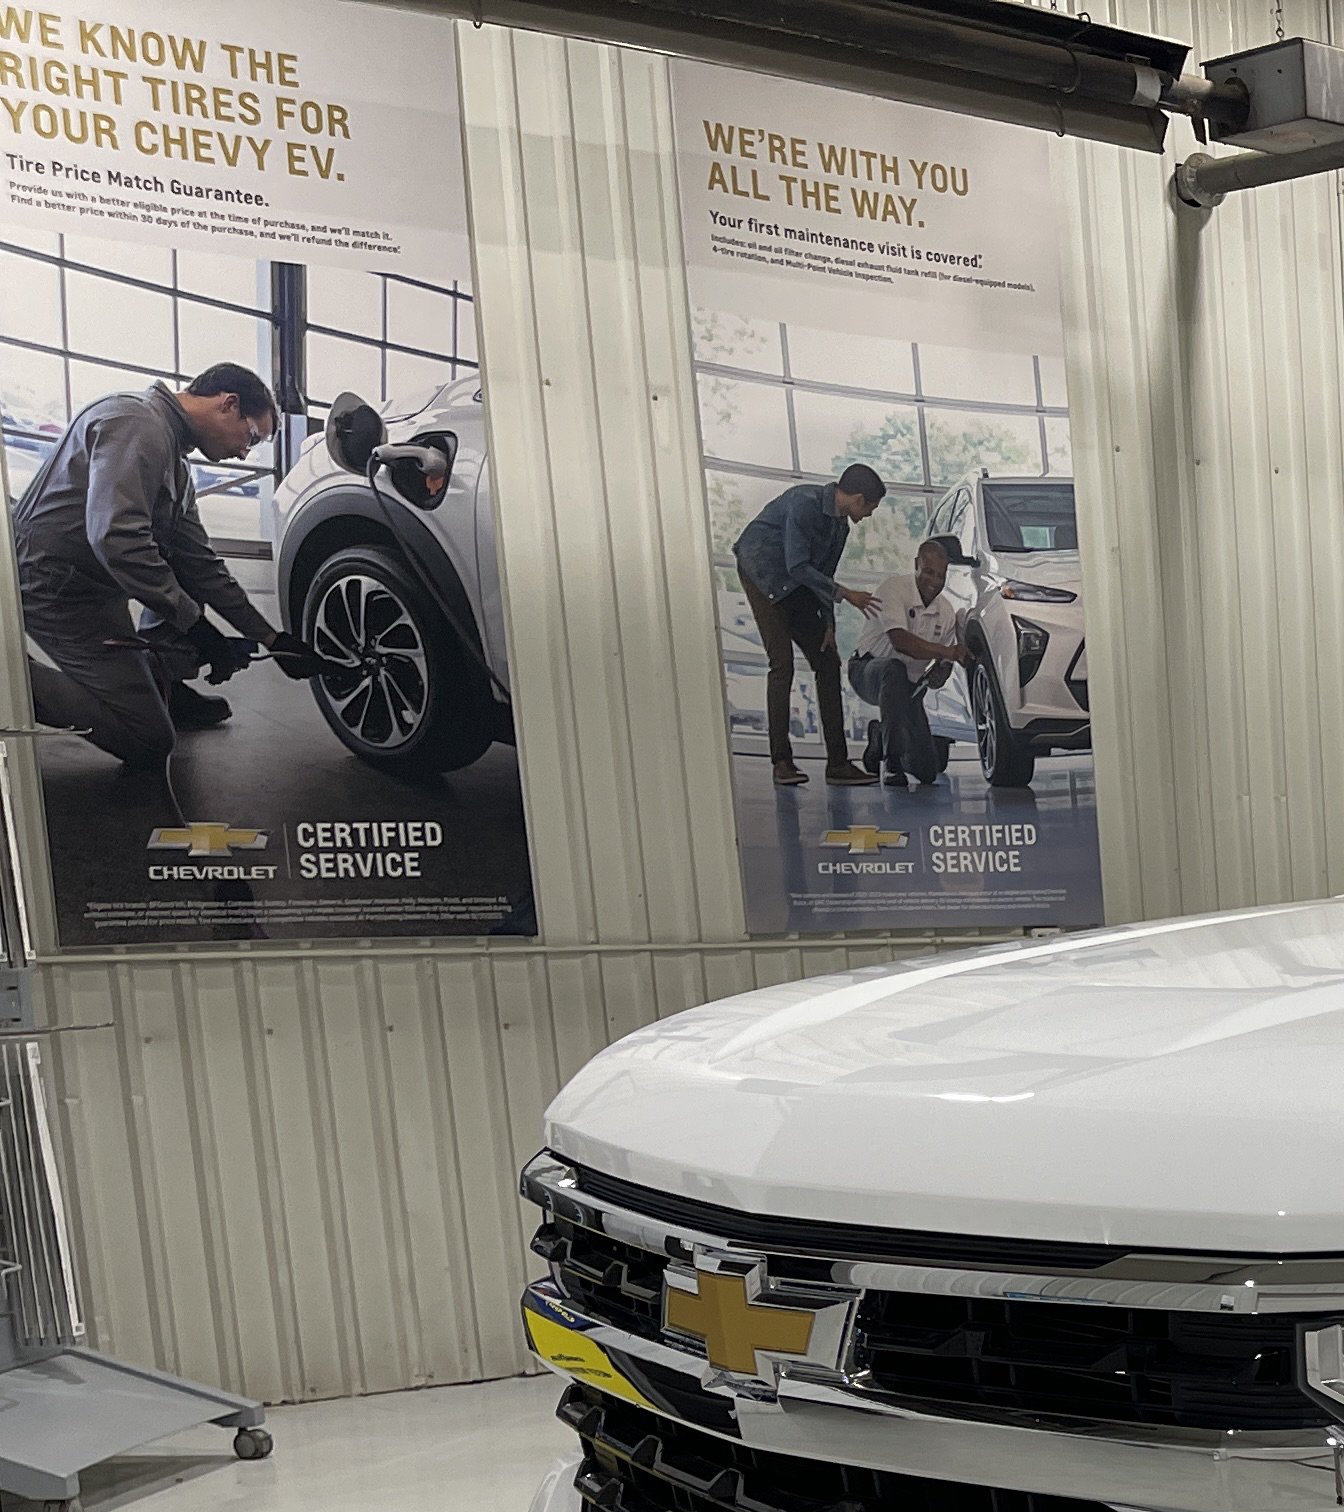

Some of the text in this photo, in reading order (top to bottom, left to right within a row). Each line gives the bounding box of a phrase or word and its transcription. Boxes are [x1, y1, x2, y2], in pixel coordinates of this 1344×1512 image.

[0, 6, 300, 89] WE KNOW THE
[0, 51, 350, 140] RIGHT TIRES FOR
[5, 97, 345, 182] YOUR CHEVY EV.
[703, 119, 969, 197] WE'RE WITH YOU
[6, 153, 270, 207] Tire Price Match Guarantee.
[707, 161, 926, 229] ALL THE WAY.
[9, 181, 393, 241] Provide us with a better eligible price at the time of purchase, and we'll match it.
[10, 194, 33, 206] Find
[36, 200, 42, 208] a
[44, 200, 76, 213] better
[79, 206, 105, 219] price
[107, 210, 138, 222] within
[140, 214, 153, 224] 30
[155, 216, 178, 228] days
[181, 220, 190, 229] of
[192, 221, 208, 231] the
[211, 224, 257, 238] purchase,
[259, 230, 276, 240] and
[279, 232, 300, 242] we'll
[302, 235, 332, 246] refund
[334, 238, 349, 248] the
[709, 209, 743, 230] Your
[747, 217, 780, 237] first
[784, 226, 875, 253] maintenance
[878, 241, 907, 258] visit
[911, 245, 922, 260] is
[296, 821, 443, 850] CERTIFIED
[929, 824, 1037, 847] CERTIFIED
[931, 850, 1022, 874] SERVICE
[147, 865, 278, 881] CHEVROLET
[300, 852, 422, 880] SERVICE
[818, 862, 915, 875] CHEVROLET
